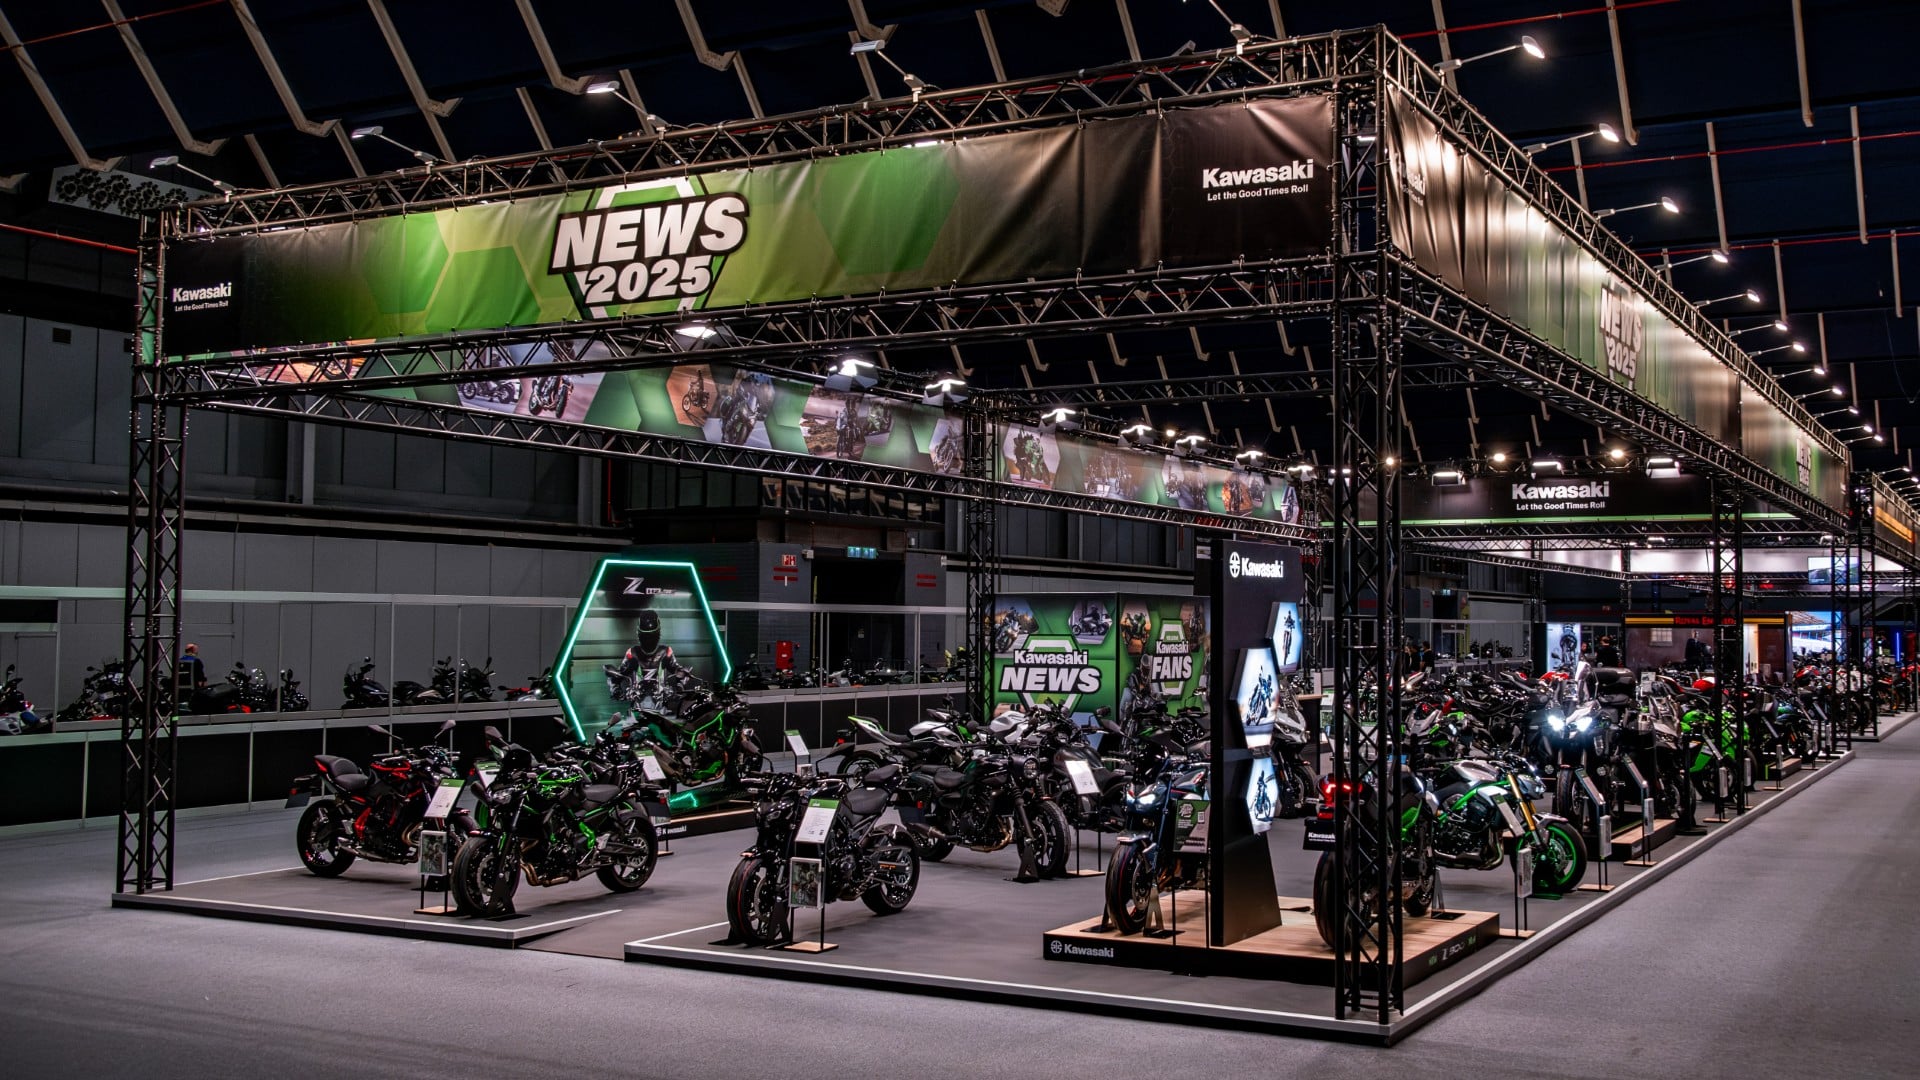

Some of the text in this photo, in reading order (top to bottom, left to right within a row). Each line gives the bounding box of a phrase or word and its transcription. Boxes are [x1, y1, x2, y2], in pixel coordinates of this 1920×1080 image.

[1202, 158, 1314, 189] Kawasaki
[1207, 184, 1309, 201] Let the Good Times Roll
[552, 196, 745, 269] NEWS
[585, 254, 711, 304] 2025
[172, 282, 232, 303] Kawasaki
[1600, 287, 1642, 353] NEWS
[1608, 337, 1637, 379] 2025
[1512, 481, 1610, 500] Kawasaki
[1516, 503, 1529, 511] Let
[1544, 502, 1565, 510] Good
[1565, 501, 1589, 509] Times
[1590, 501, 1605, 509] Roll
[1241, 557, 1284, 578] Kawasaki
[1014, 649, 1088, 665] Kawasaki
[1156, 640, 1189, 654] Kawasaki
[1151, 655, 1193, 680] FANS
[1000, 666, 1100, 693] NEWS
[1064, 943, 1114, 958] Kawasaki
